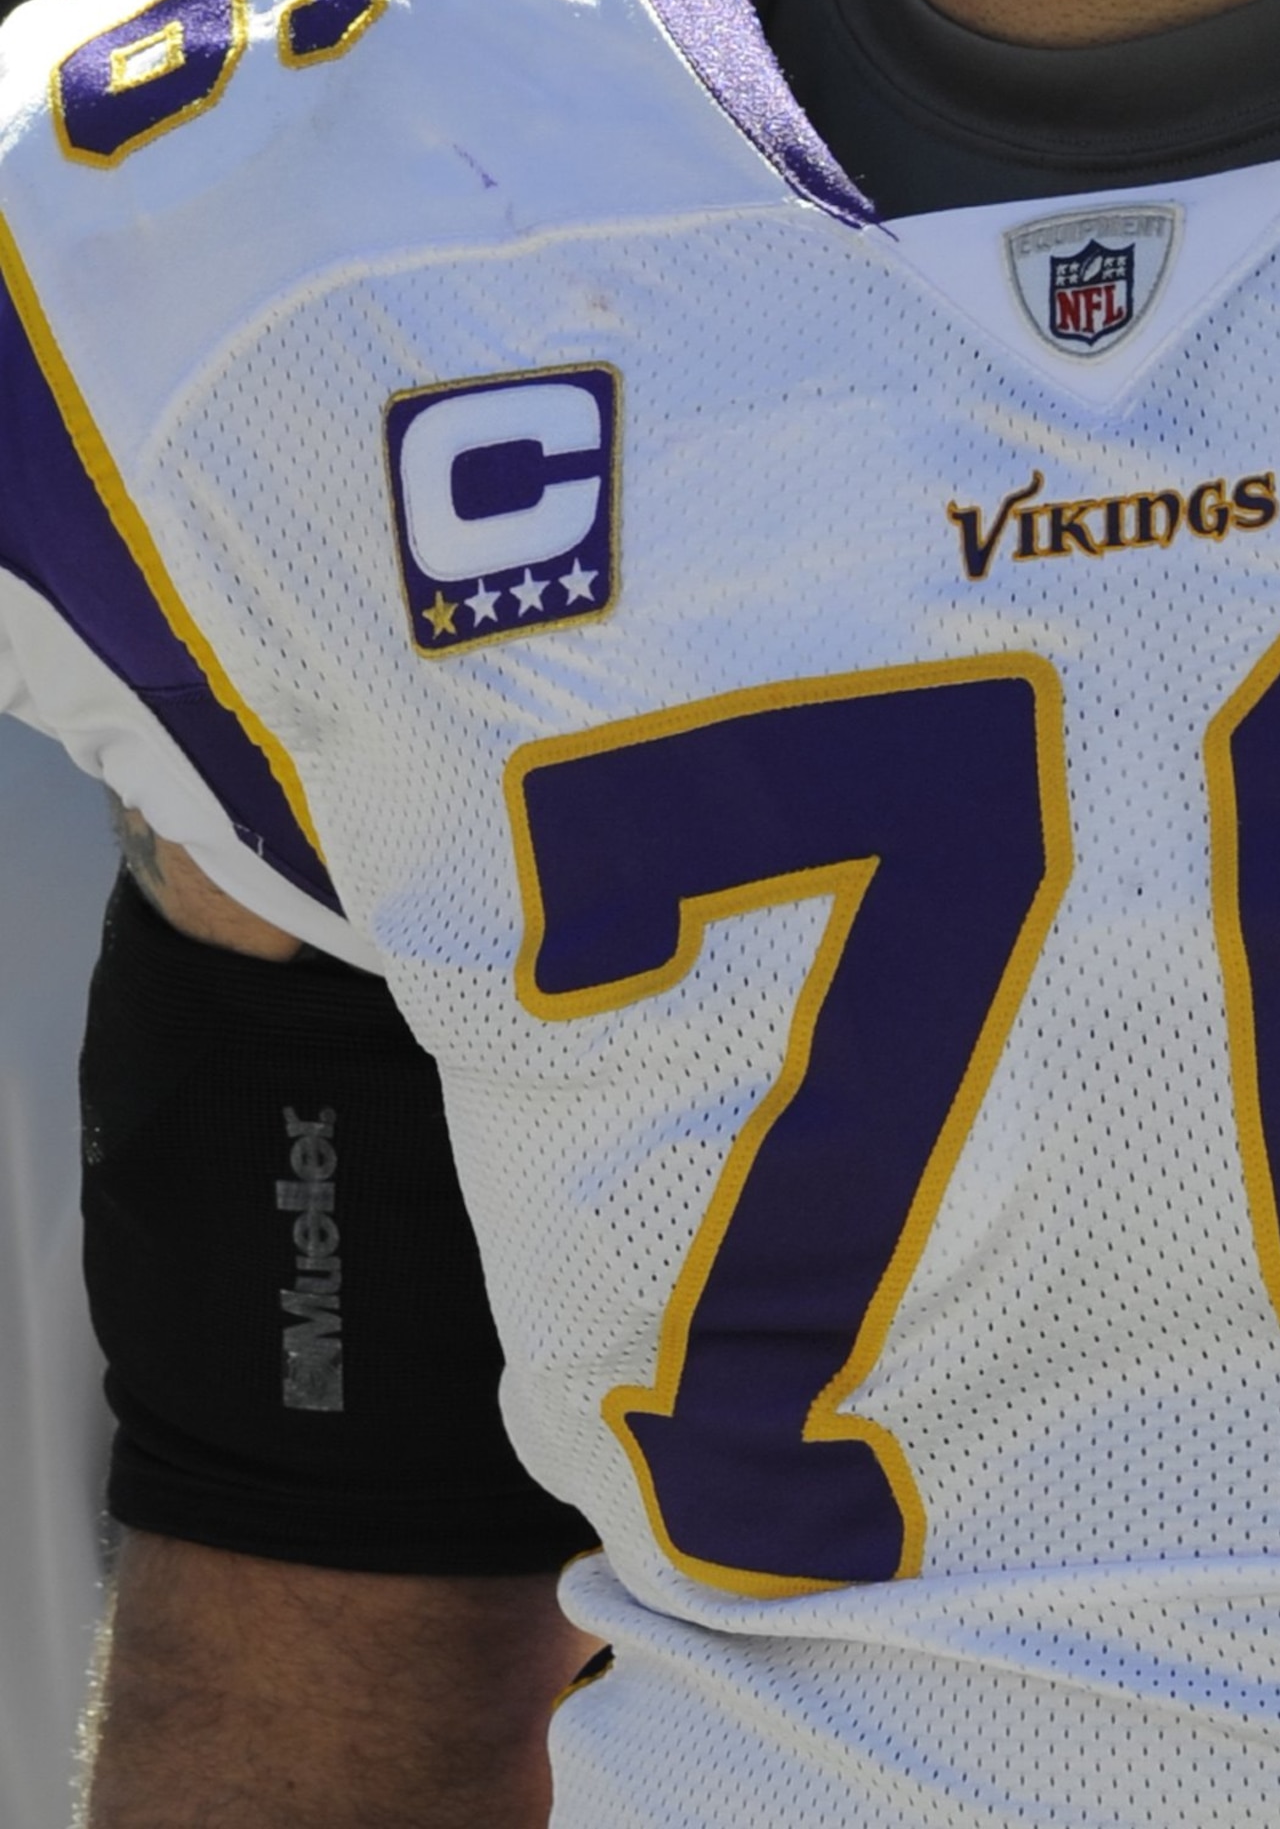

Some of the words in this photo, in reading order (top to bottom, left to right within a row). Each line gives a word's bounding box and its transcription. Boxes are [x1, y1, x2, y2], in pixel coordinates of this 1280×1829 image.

[1056, 284, 1124, 334] NFL
[400, 383, 601, 582] C
[947, 469, 1280, 581] VIKINGS
